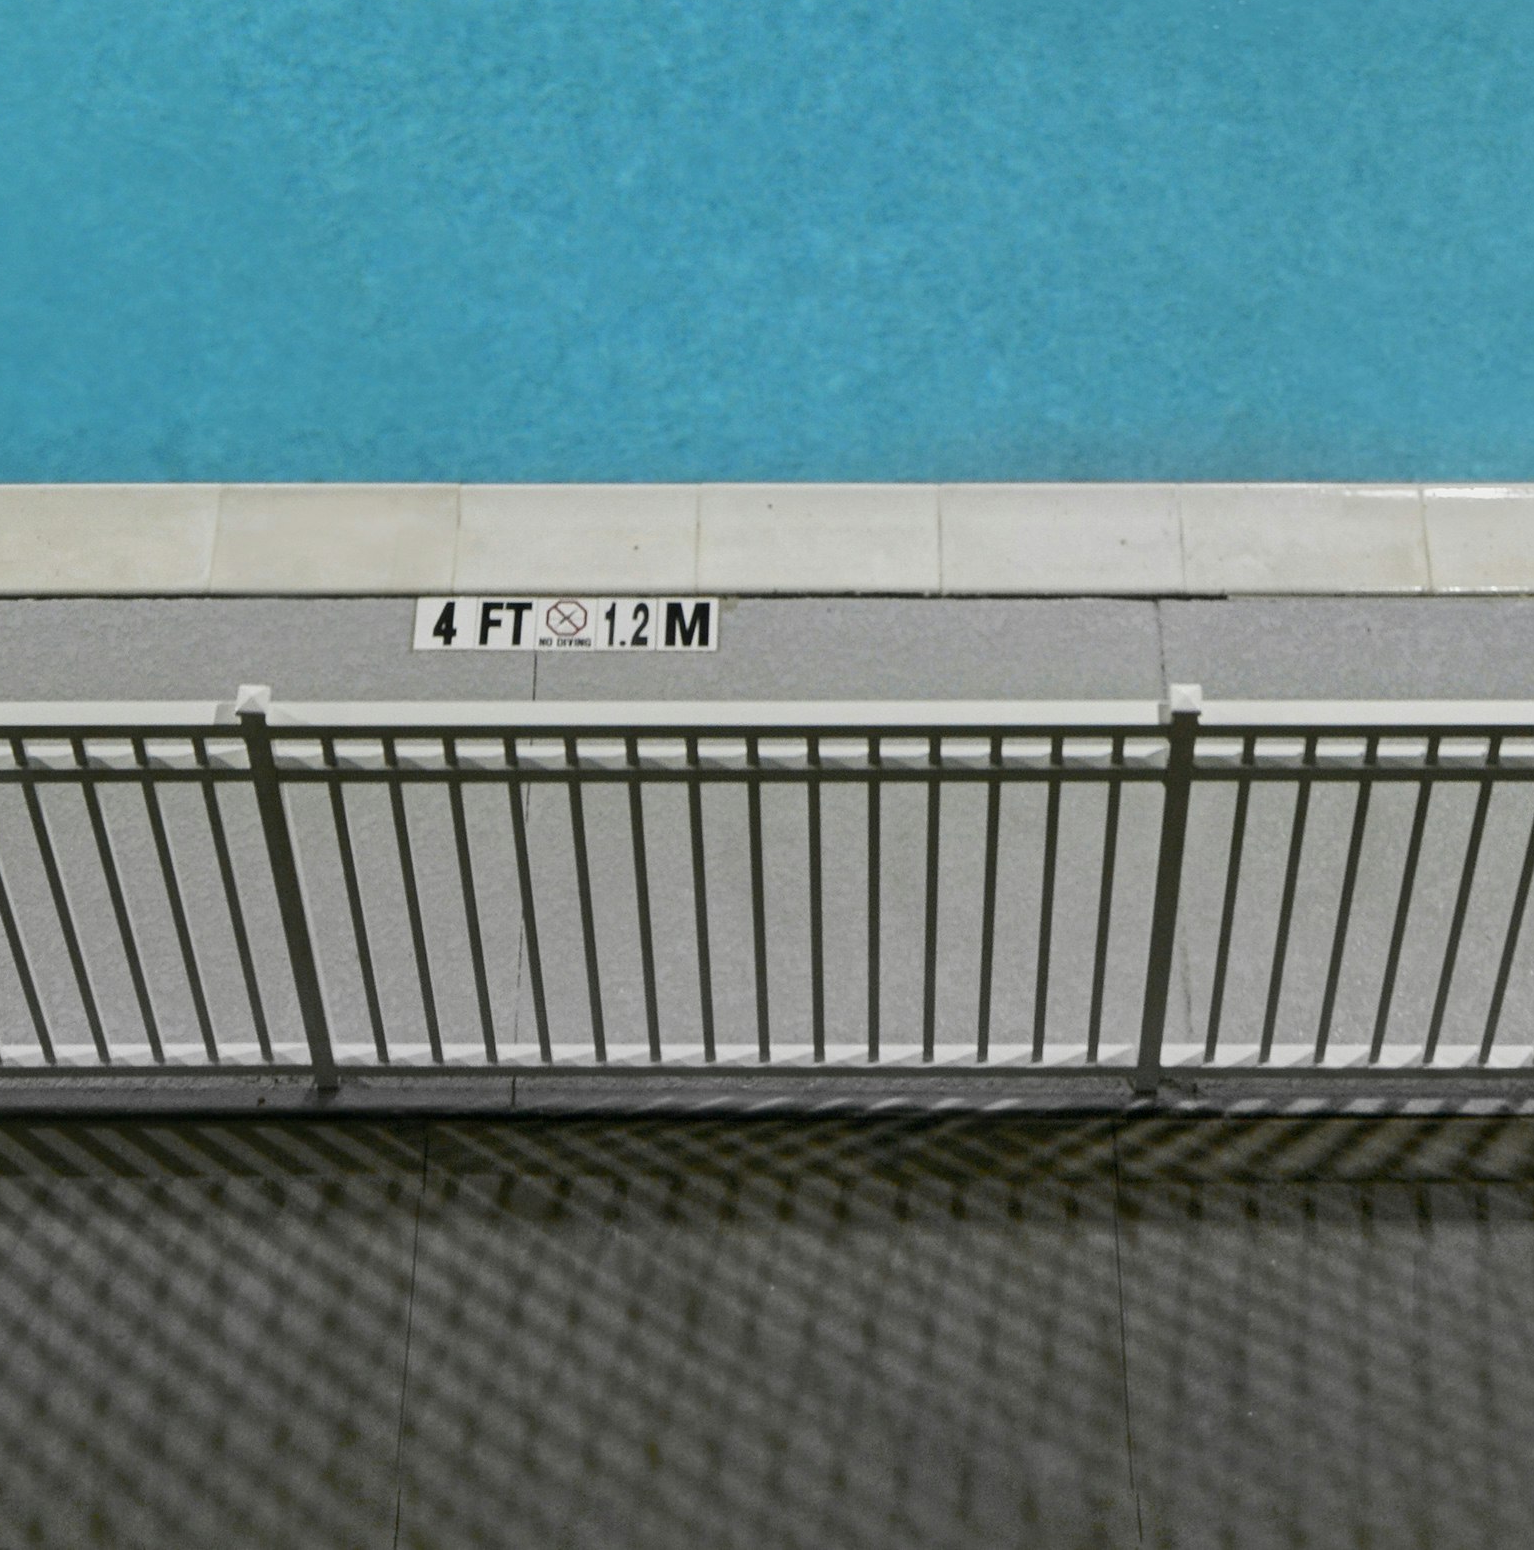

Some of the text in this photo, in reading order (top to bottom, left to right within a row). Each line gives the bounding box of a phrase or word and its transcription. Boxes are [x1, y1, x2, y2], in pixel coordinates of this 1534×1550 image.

[433, 602, 710, 647] 4 FT 1.2 M
[539, 638, 591, 647] NO DIVING
